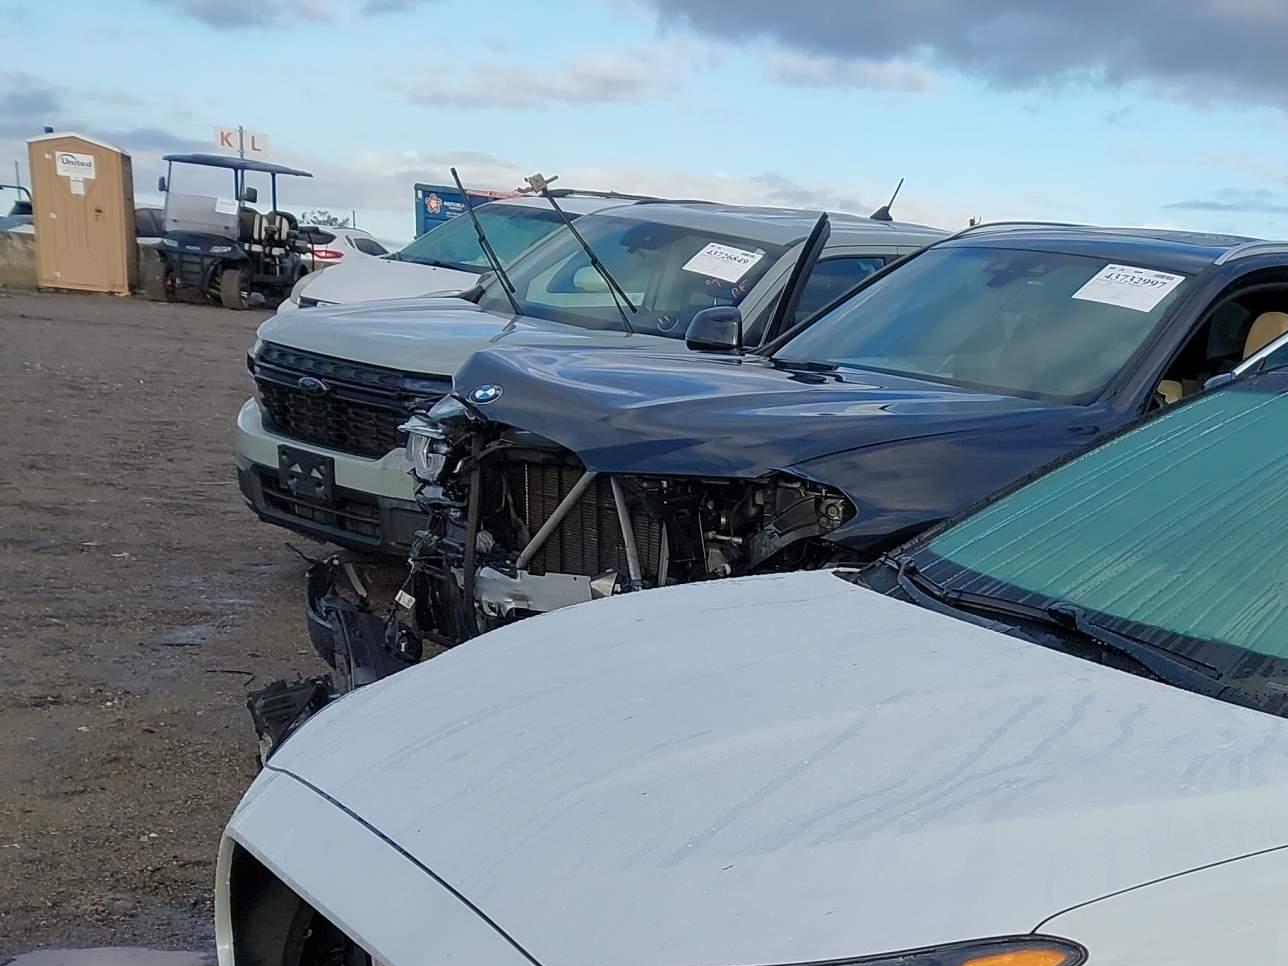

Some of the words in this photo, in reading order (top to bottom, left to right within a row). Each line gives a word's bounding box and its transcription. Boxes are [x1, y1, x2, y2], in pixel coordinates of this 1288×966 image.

[220, 131, 233, 147] K
[251, 136, 262, 151] L
[61, 157, 92, 168] United
[1104, 272, 1167, 288] 43732997
